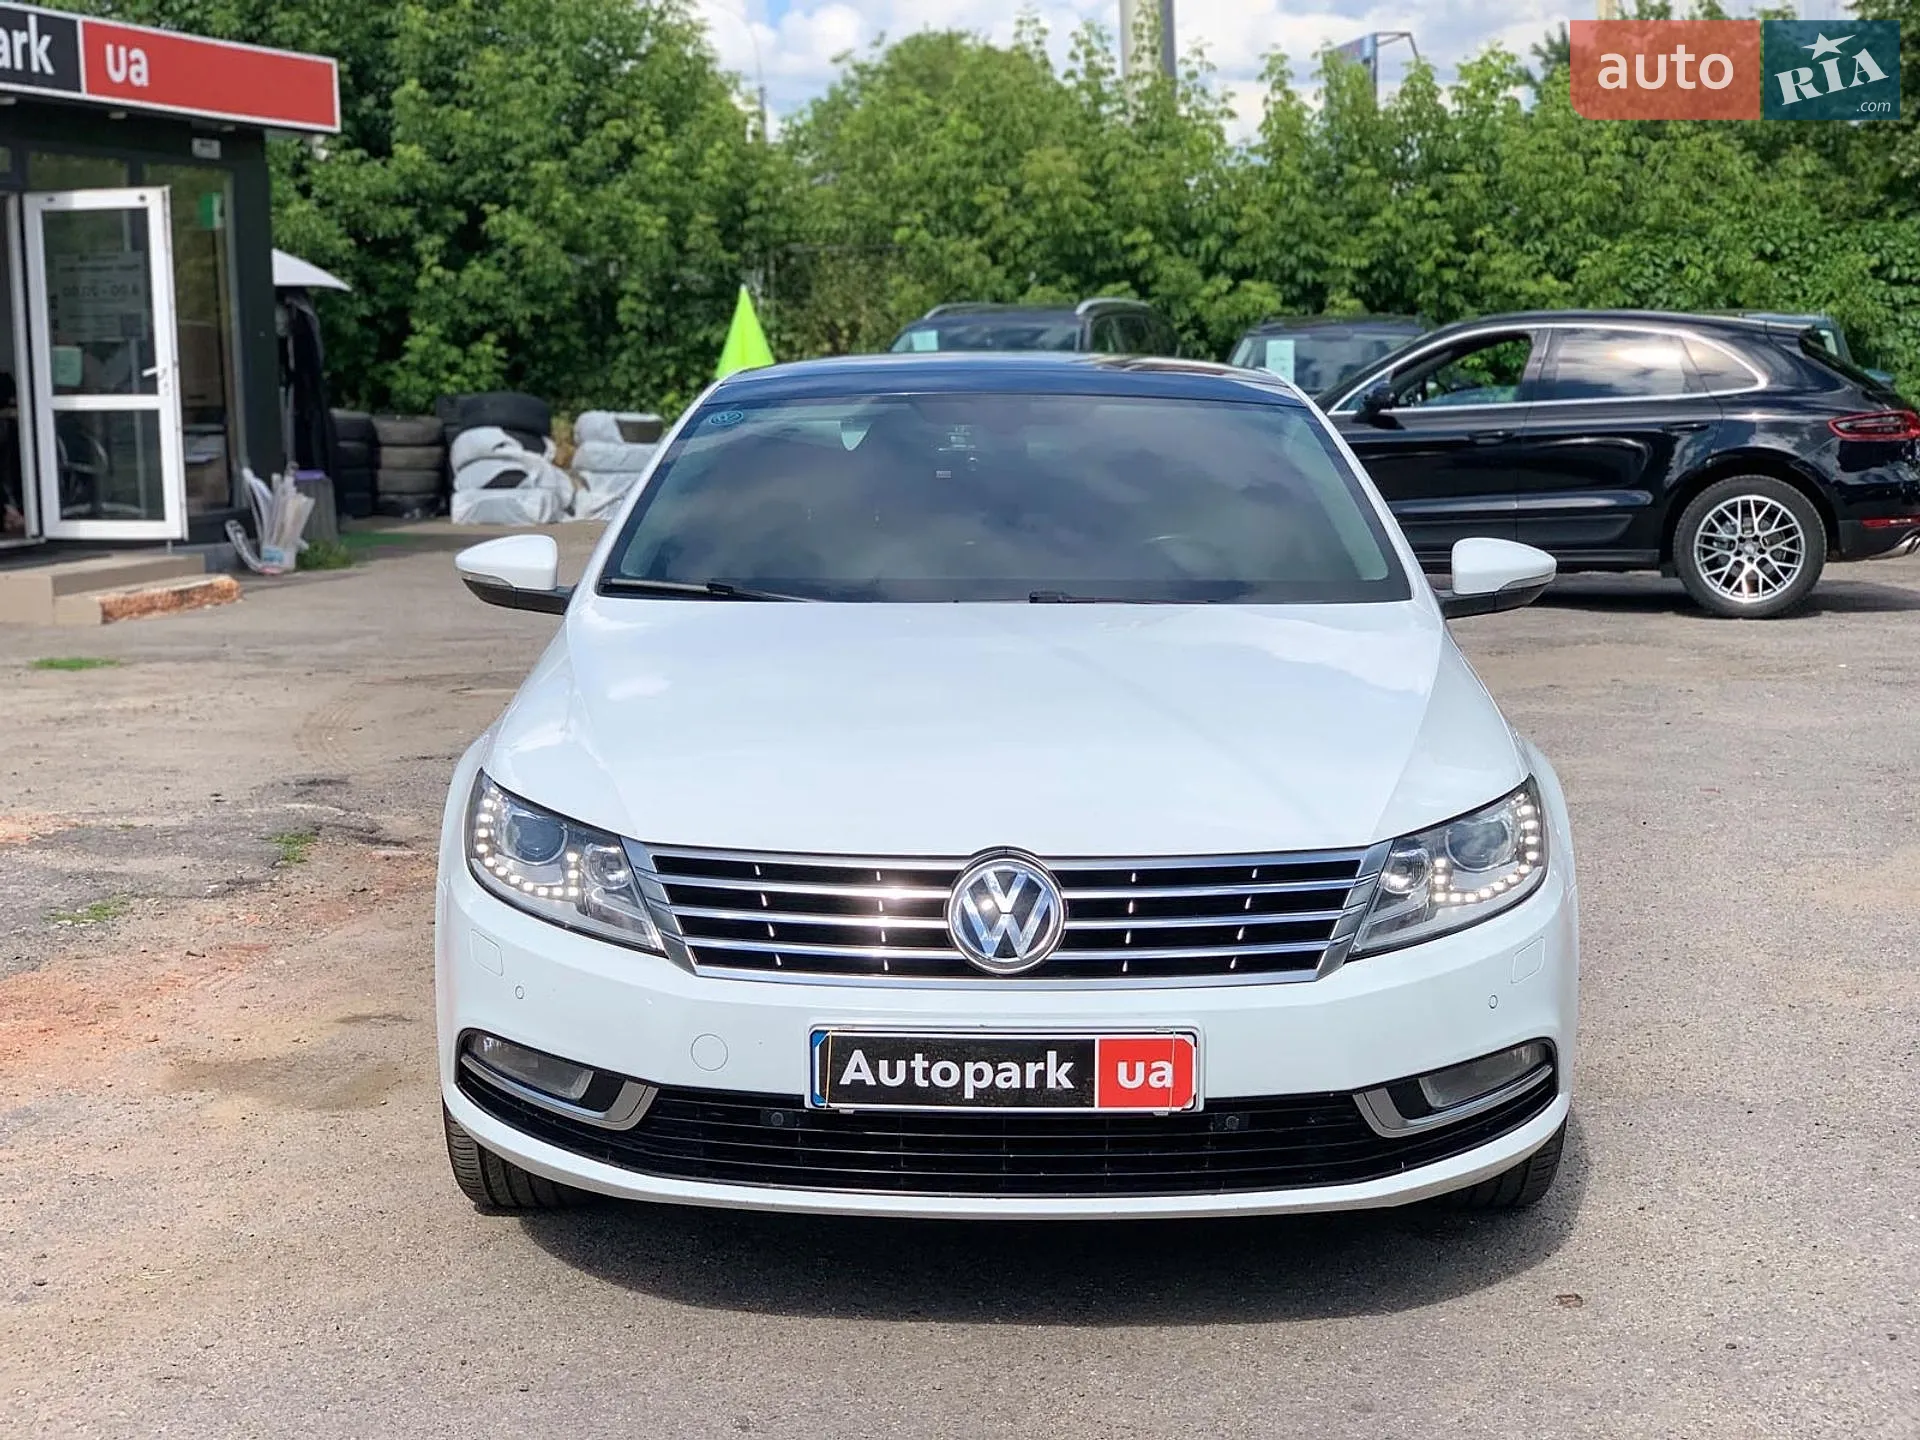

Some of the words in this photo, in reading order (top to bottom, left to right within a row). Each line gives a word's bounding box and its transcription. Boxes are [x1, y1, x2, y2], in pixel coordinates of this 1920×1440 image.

[105, 43, 149, 87] ua
[839, 1049, 1075, 1099] Autopark
[1116, 1060, 1173, 1089] ua
